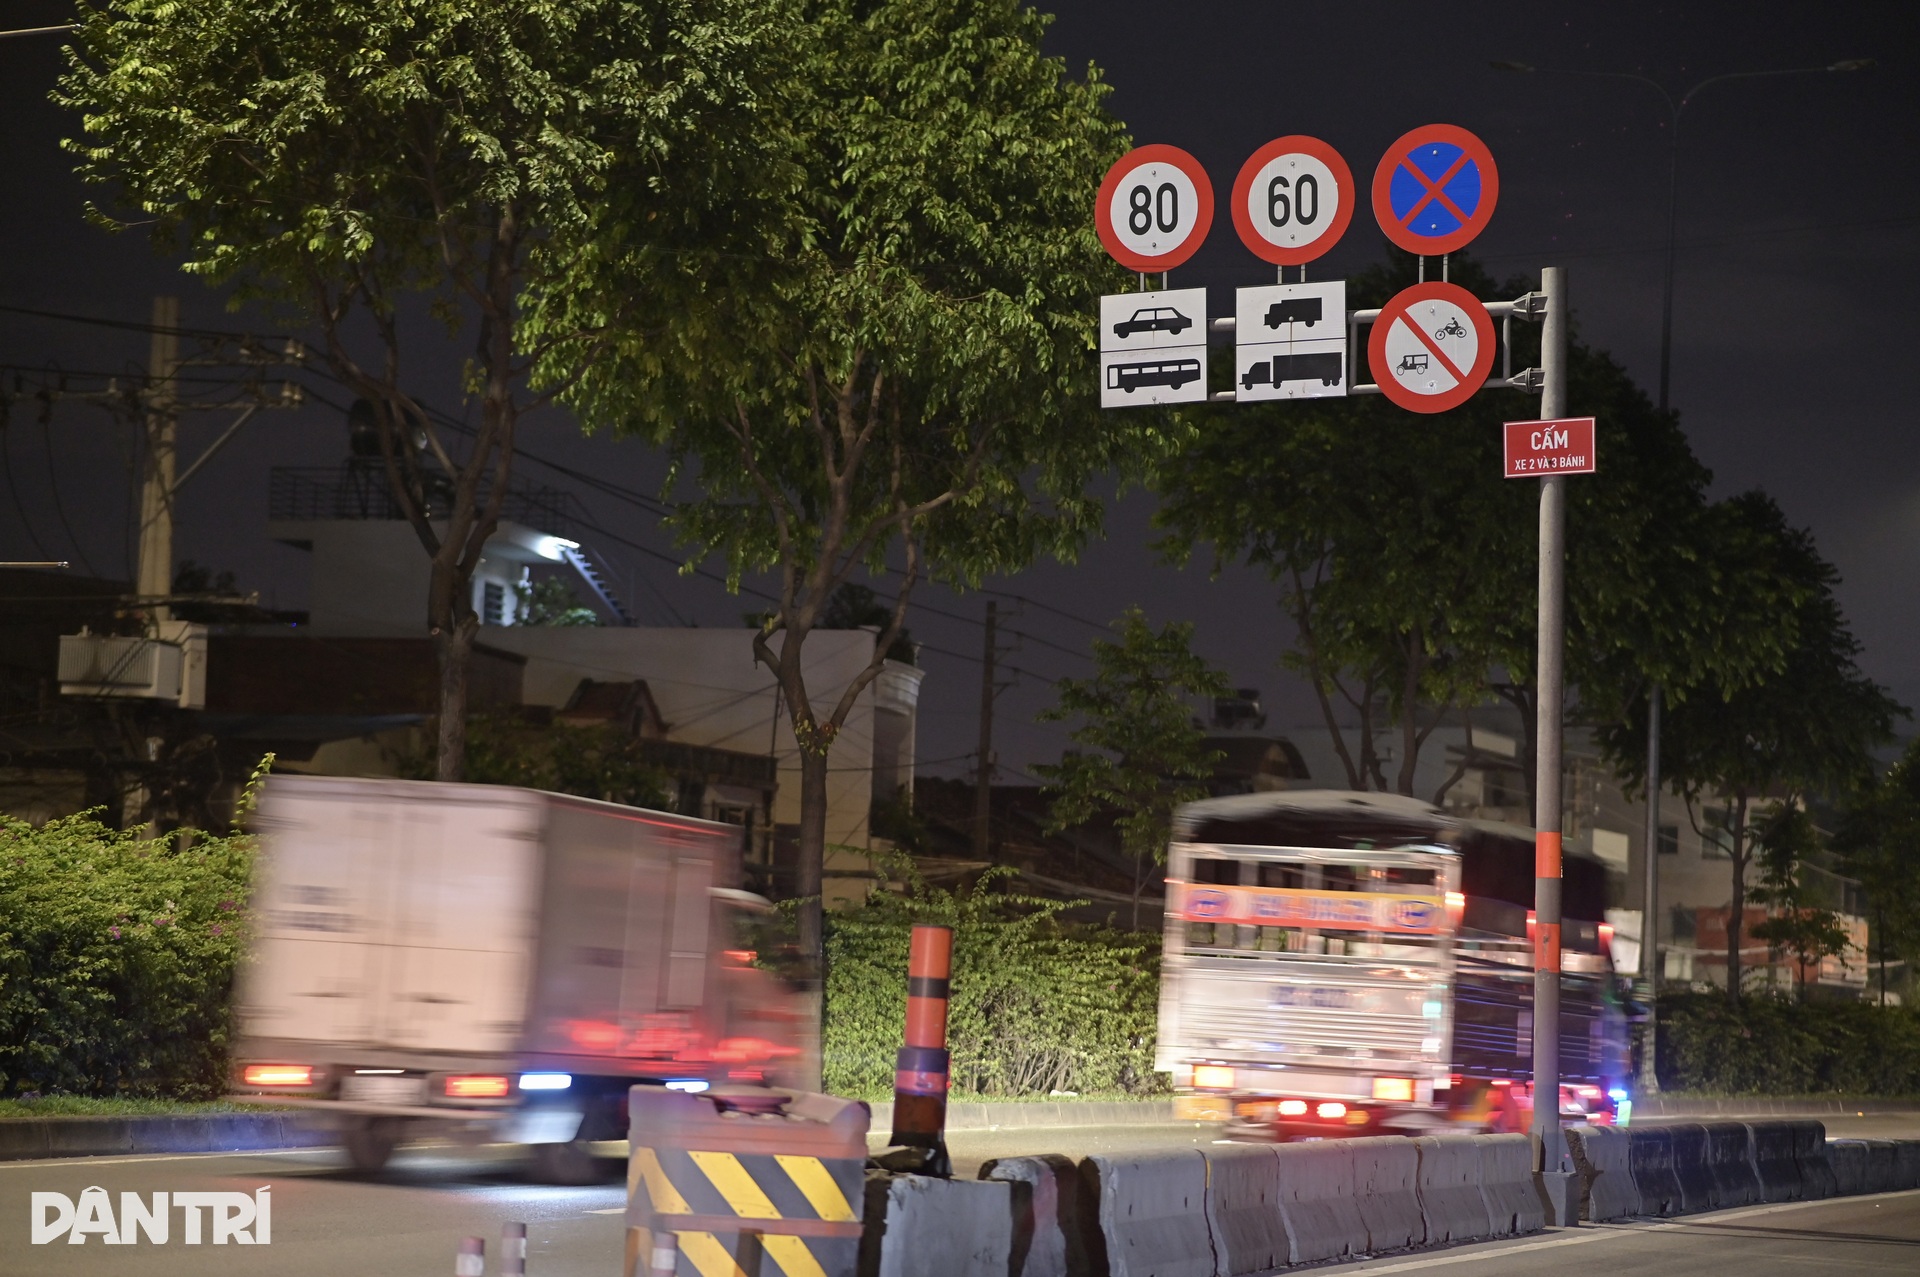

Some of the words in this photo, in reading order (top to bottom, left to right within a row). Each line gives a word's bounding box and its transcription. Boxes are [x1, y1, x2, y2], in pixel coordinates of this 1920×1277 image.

[1128, 182, 1179, 236] 80
[1268, 173, 1318, 228] 60
[1530, 424, 1569, 451] CẤM
[1514, 458, 1527, 471] XE
[1529, 459, 1535, 470] 2
[1537, 455, 1550, 469] VÀ
[1551, 457, 1557, 469] 3
[1560, 453, 1585, 468] BÁNH
